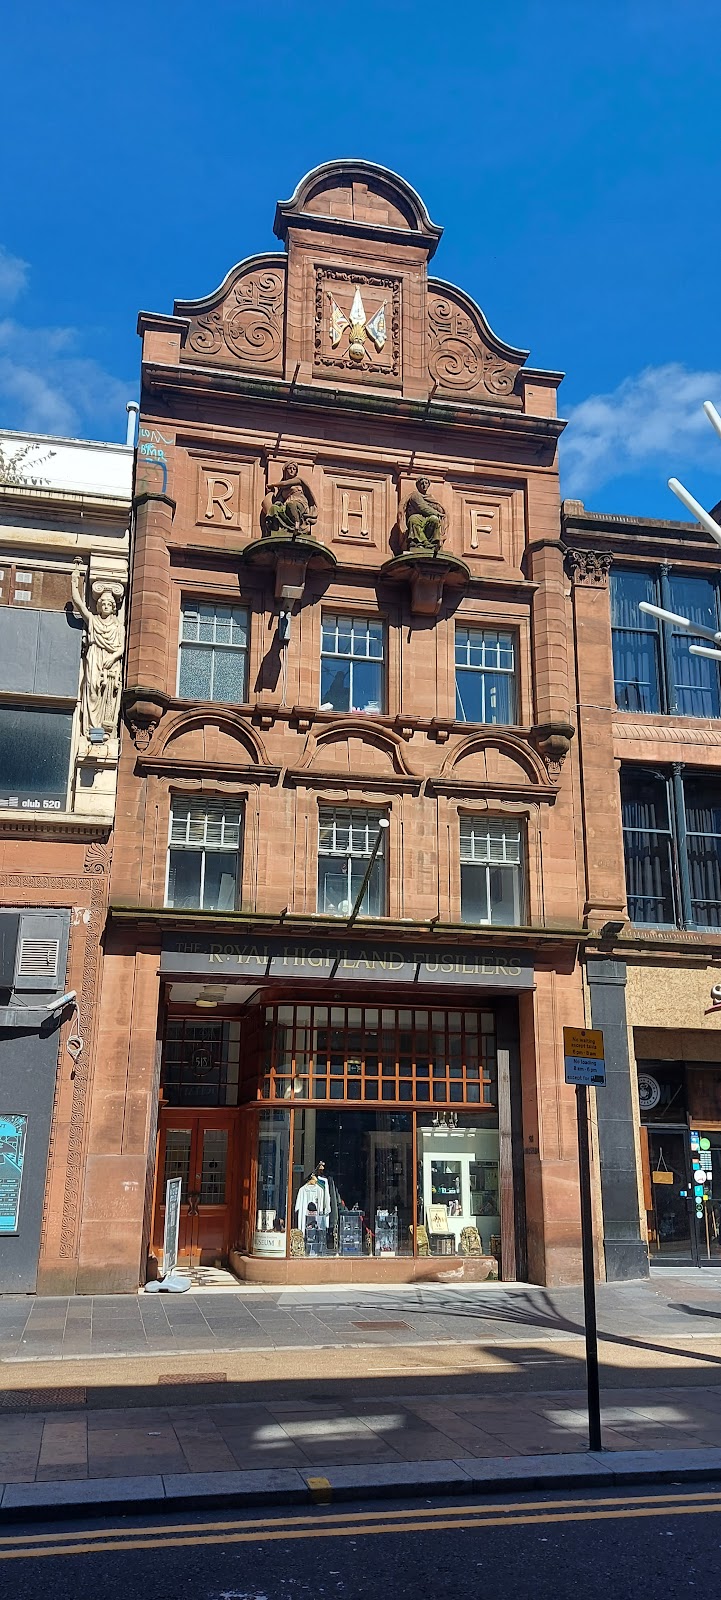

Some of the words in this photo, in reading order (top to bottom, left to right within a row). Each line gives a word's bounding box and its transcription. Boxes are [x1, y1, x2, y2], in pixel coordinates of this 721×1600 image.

[205, 477, 236, 519] R
[341, 492, 370, 536] H
[470, 509, 496, 549] F
[22, 799, 40, 808] club
[43, 800, 61, 809] 520
[176, 942, 202, 953] THE
[282, 946, 405, 970] HIGHLAND
[412, 952, 522, 976] FUSILIERS
